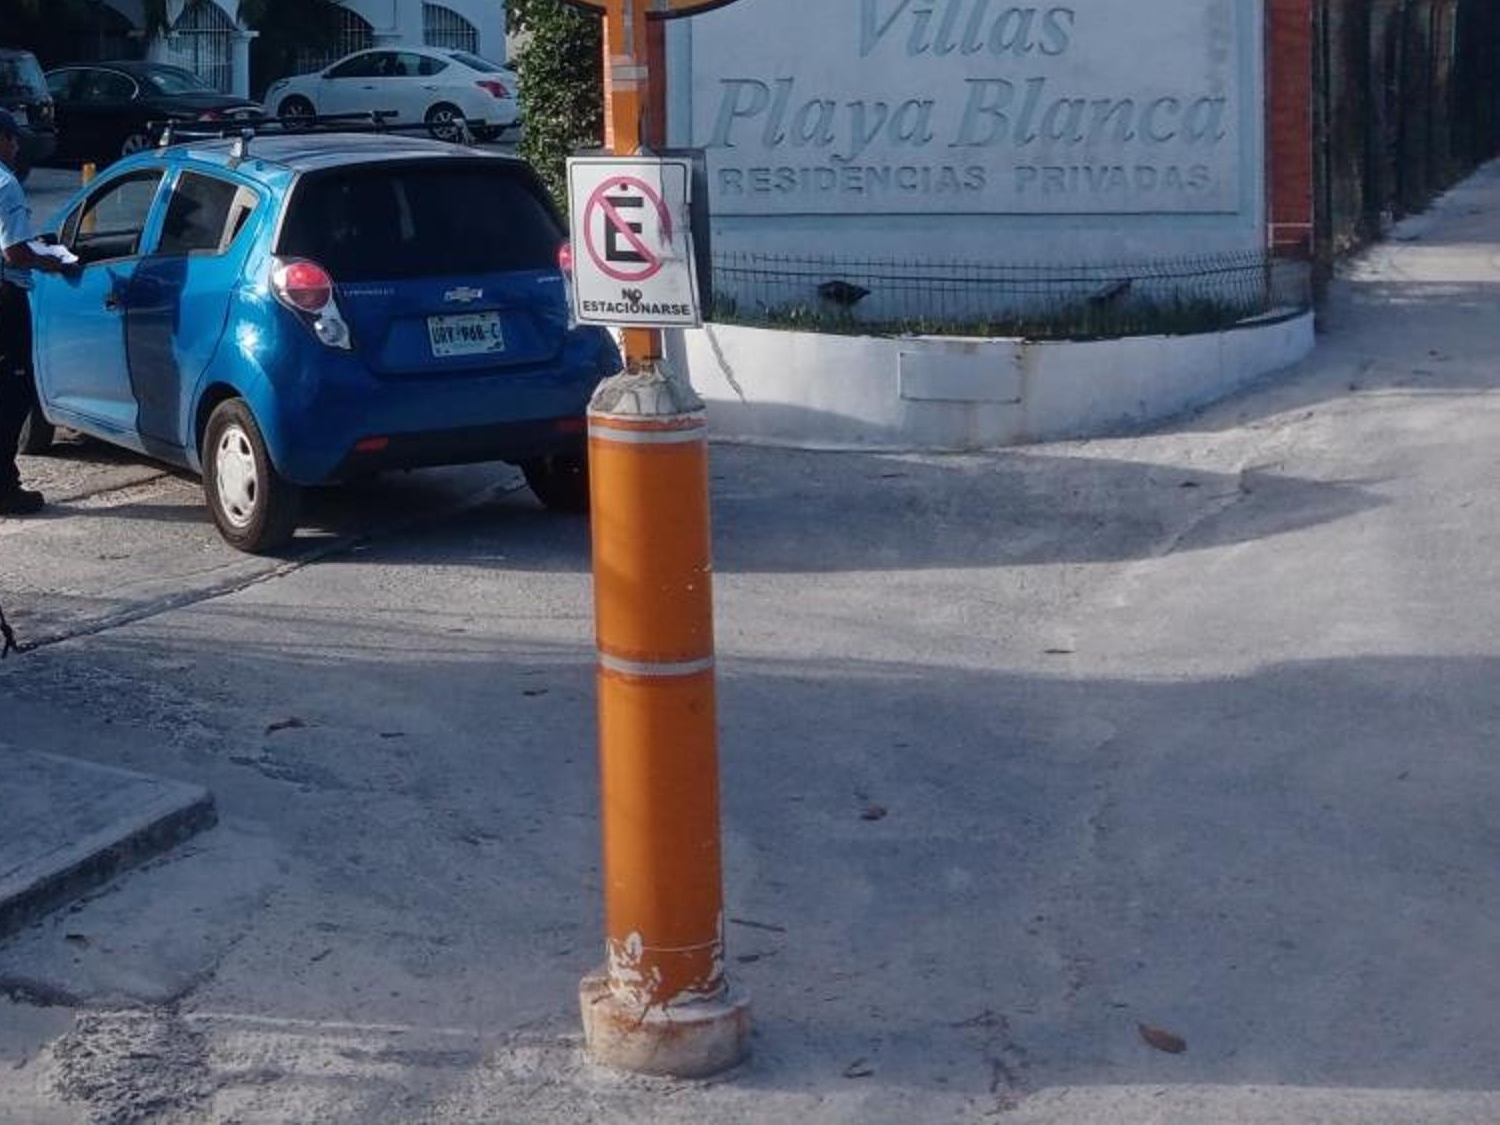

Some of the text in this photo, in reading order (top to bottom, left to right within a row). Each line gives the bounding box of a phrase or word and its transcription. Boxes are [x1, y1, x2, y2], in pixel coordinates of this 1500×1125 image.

[703, 76, 1227, 162] Playa Blanca
[717, 164, 1212, 195] RESIDENCIAS PRIVADAS
[621, 287, 644, 301] NO
[582, 299, 692, 317] ESTACIONARSE
